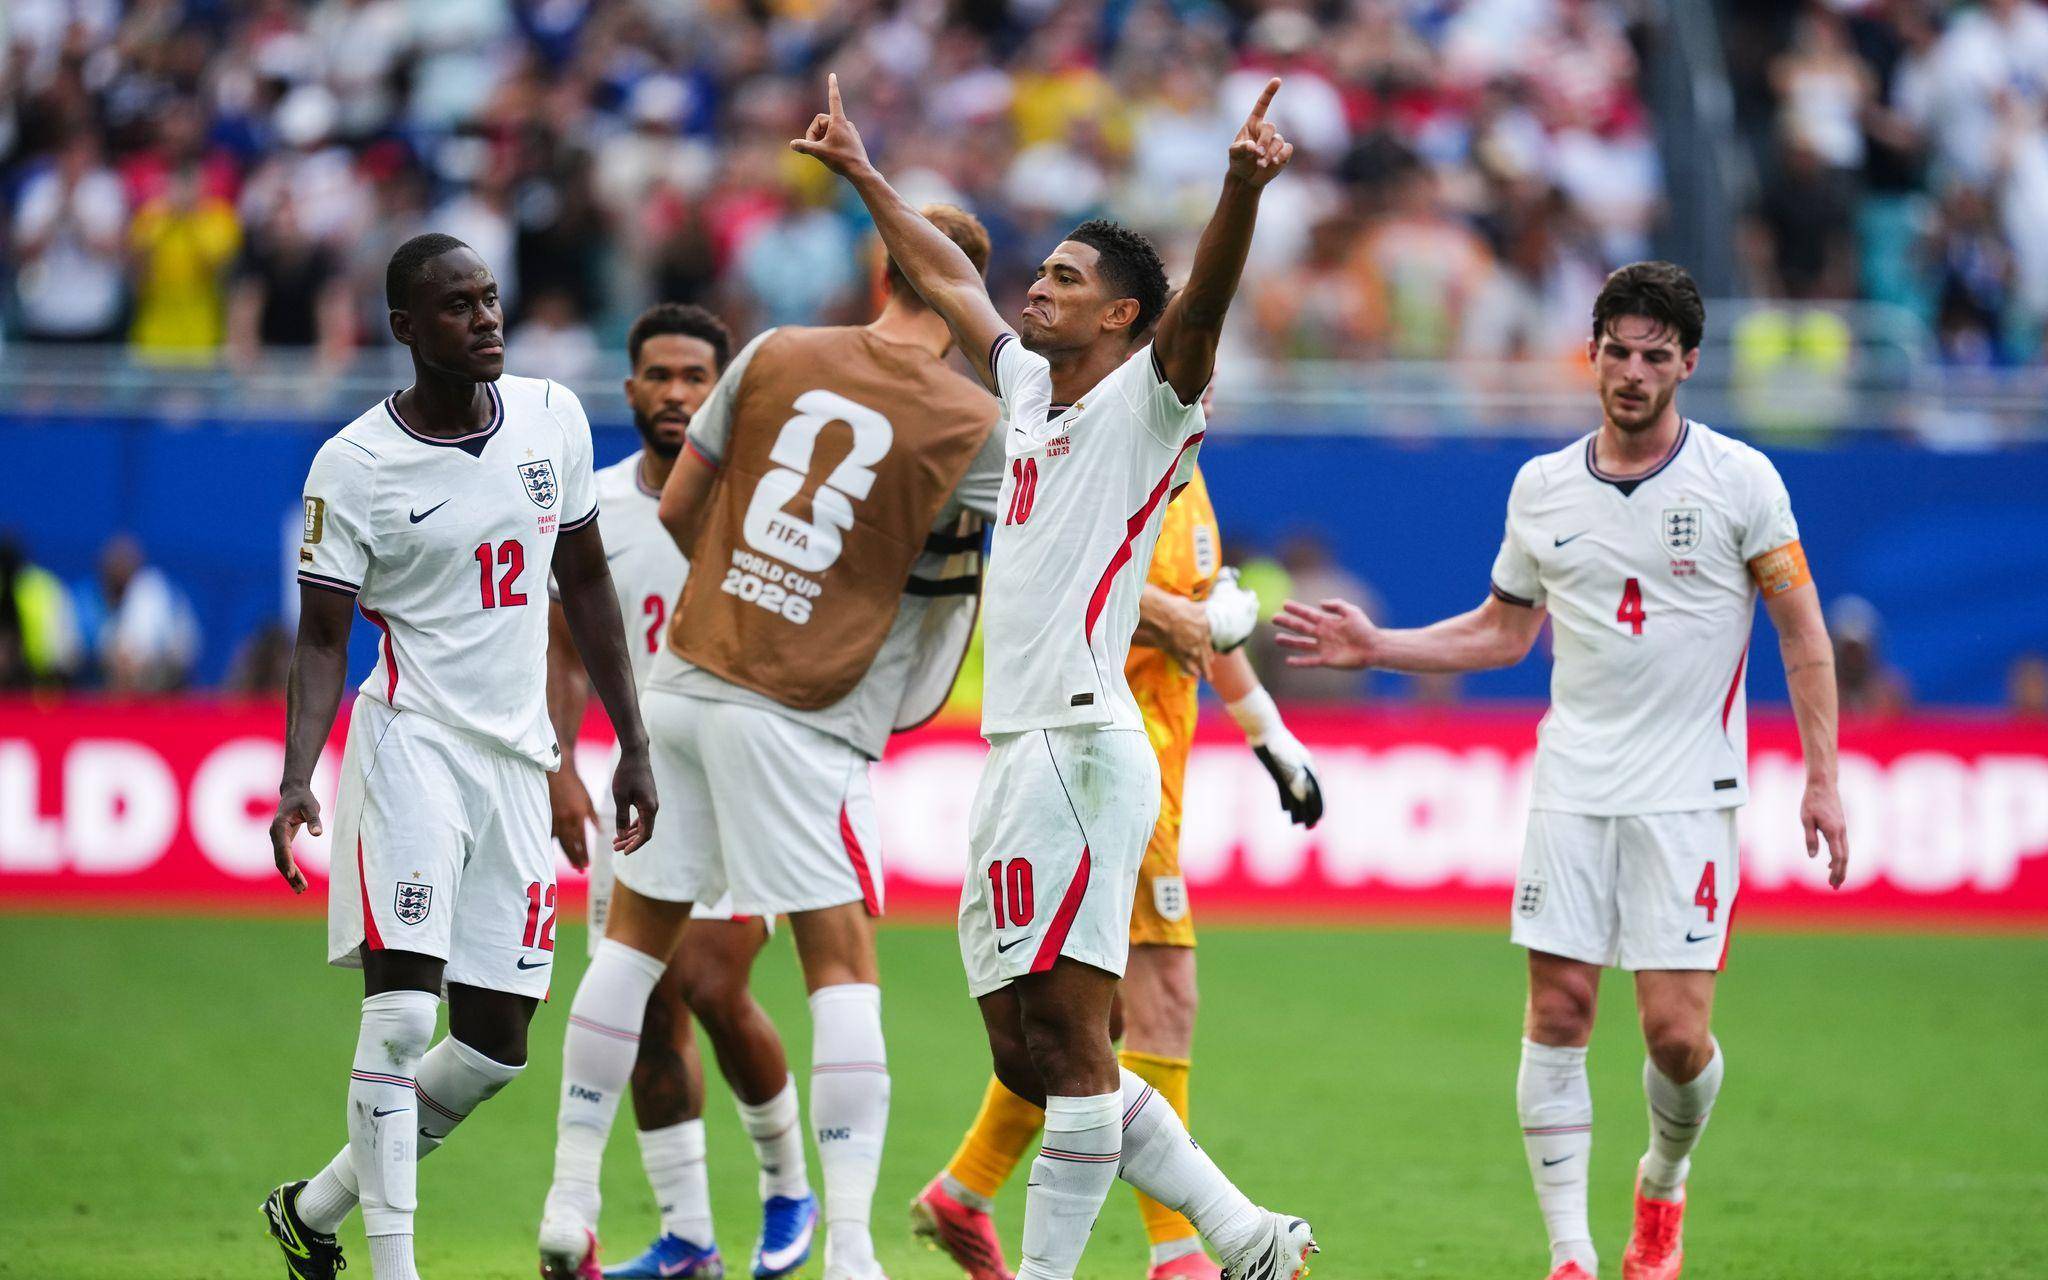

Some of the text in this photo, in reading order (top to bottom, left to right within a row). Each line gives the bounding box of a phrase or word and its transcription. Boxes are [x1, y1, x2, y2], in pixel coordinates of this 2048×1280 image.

[1005, 457, 1038, 526] 10
[766, 520, 809, 551] FIFA
[474, 539, 528, 610] 12
[720, 567, 813, 625] 2026
[731, 548, 823, 598] WORLD CUP
[1617, 577, 1646, 636] 4
[522, 881, 557, 952] 12
[987, 856, 1034, 930] 10
[1694, 860, 1719, 923] 4
